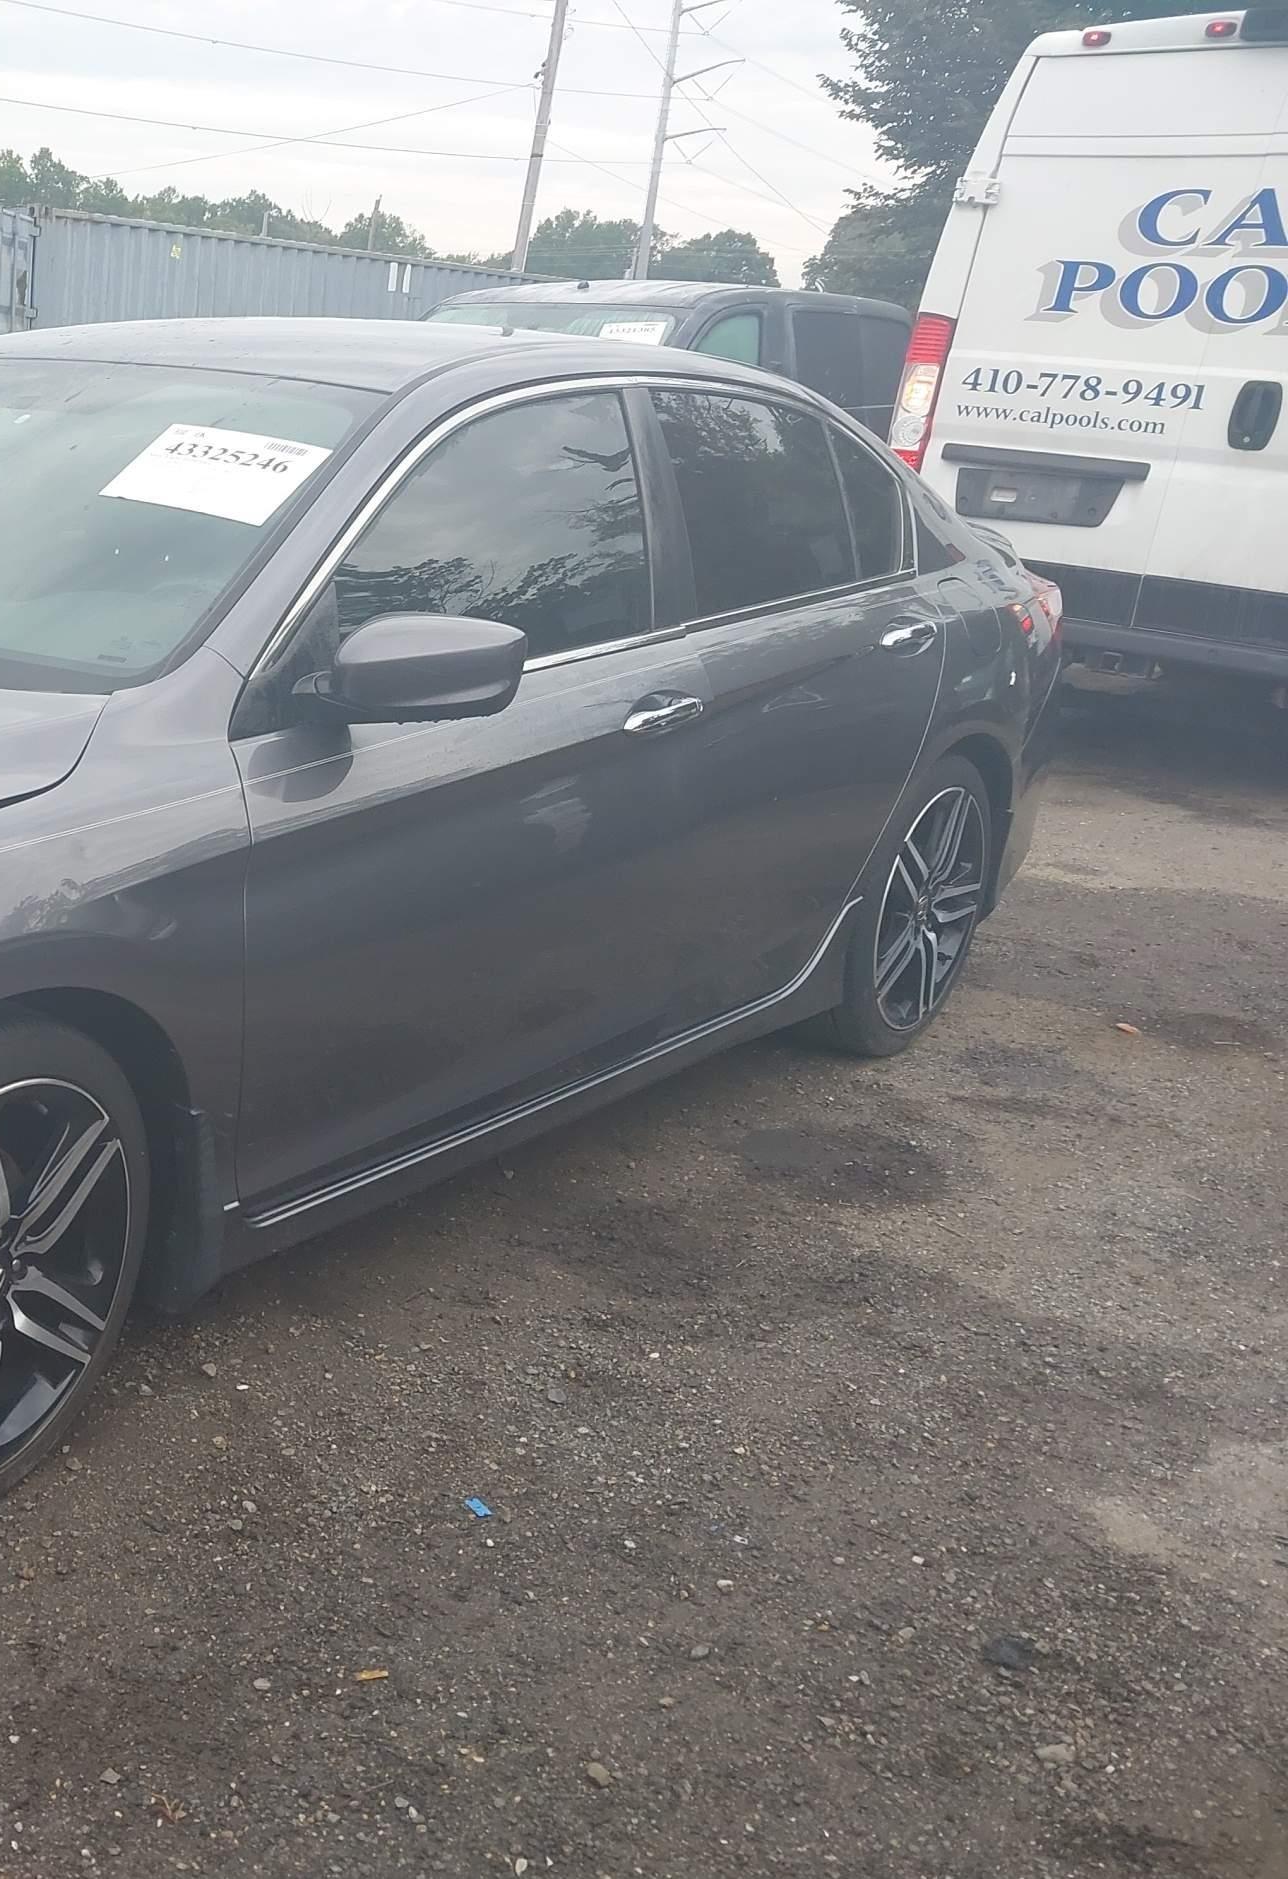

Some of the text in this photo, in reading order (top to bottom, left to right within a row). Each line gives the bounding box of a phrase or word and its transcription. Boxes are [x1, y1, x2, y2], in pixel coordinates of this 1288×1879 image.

[961, 366, 1206, 411] 410-778-9491
[956, 403, 1166, 435] www.calpools.com
[165, 442, 290, 474] 43325246
